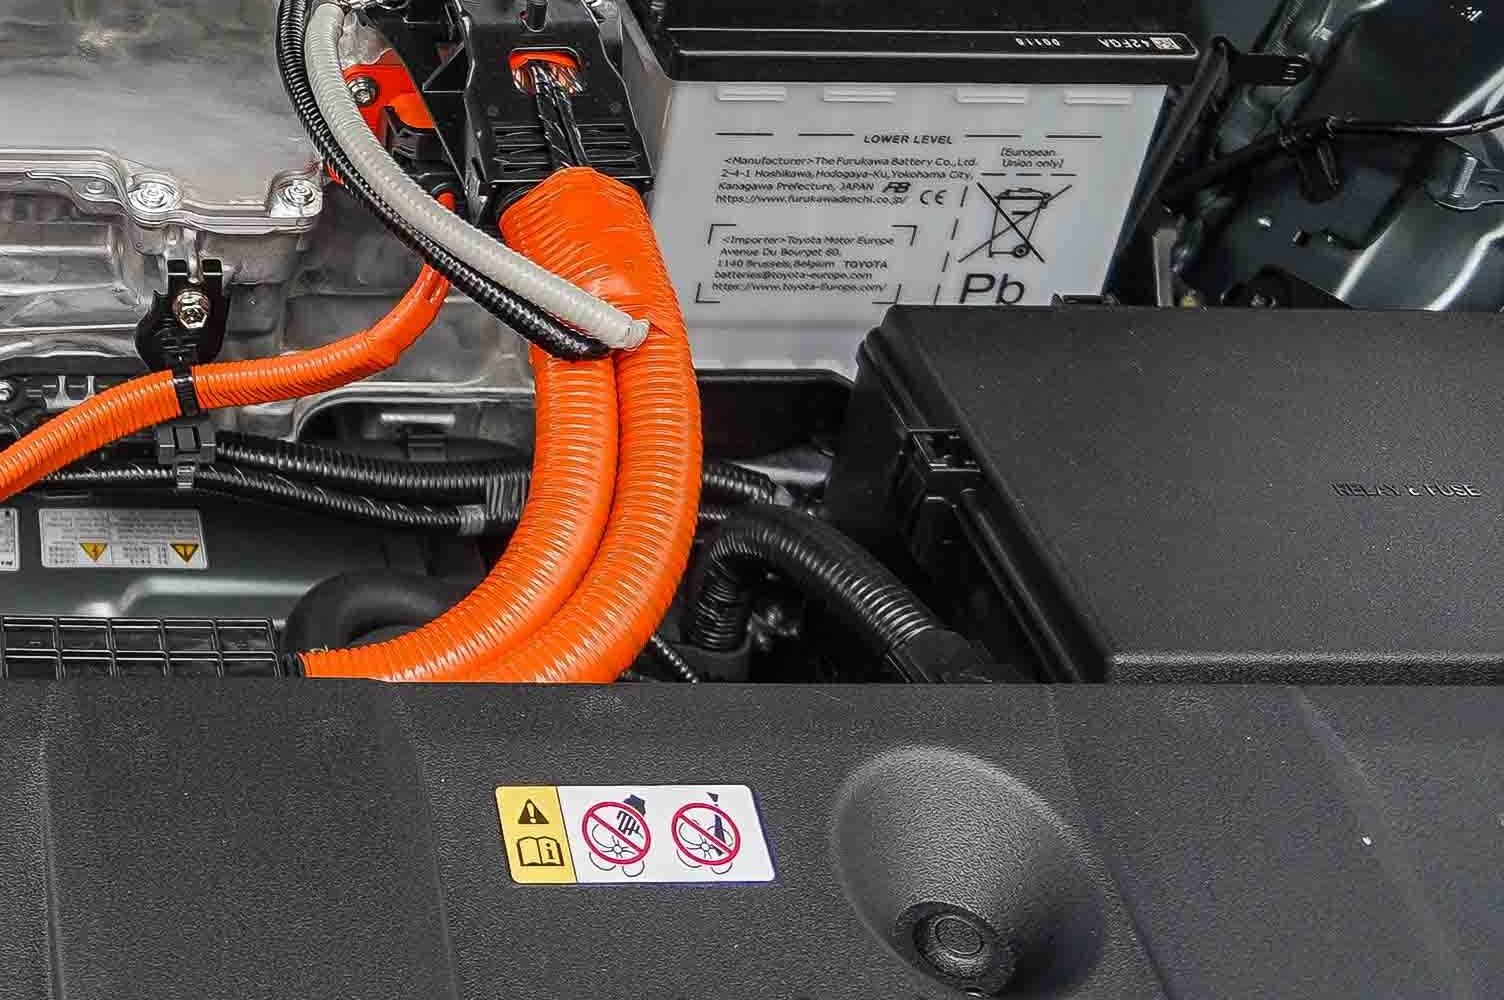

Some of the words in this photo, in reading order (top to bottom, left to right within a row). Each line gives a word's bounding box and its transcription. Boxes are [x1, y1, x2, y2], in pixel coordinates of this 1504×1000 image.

[863, 135, 909, 145] LOWER
[913, 135, 953, 145] LEVEL
[837, 156, 889, 166] Furukawa
[891, 157, 933, 168] Battery
[1002, 160, 1033, 168] Union
[718, 182, 774, 192] Kanagawa
[839, 182, 875, 191] JAPAN
[823, 236, 855, 246] Motor
[856, 236, 895, 247] Europe
[720, 248, 759, 256] Avenue
[761, 248, 777, 256] Du
[717, 259, 744, 268] 1140
[844, 260, 888, 269] TOYOTA
[959, 273, 1025, 304] Pb
[1422, 482, 1481, 497] FUSE
